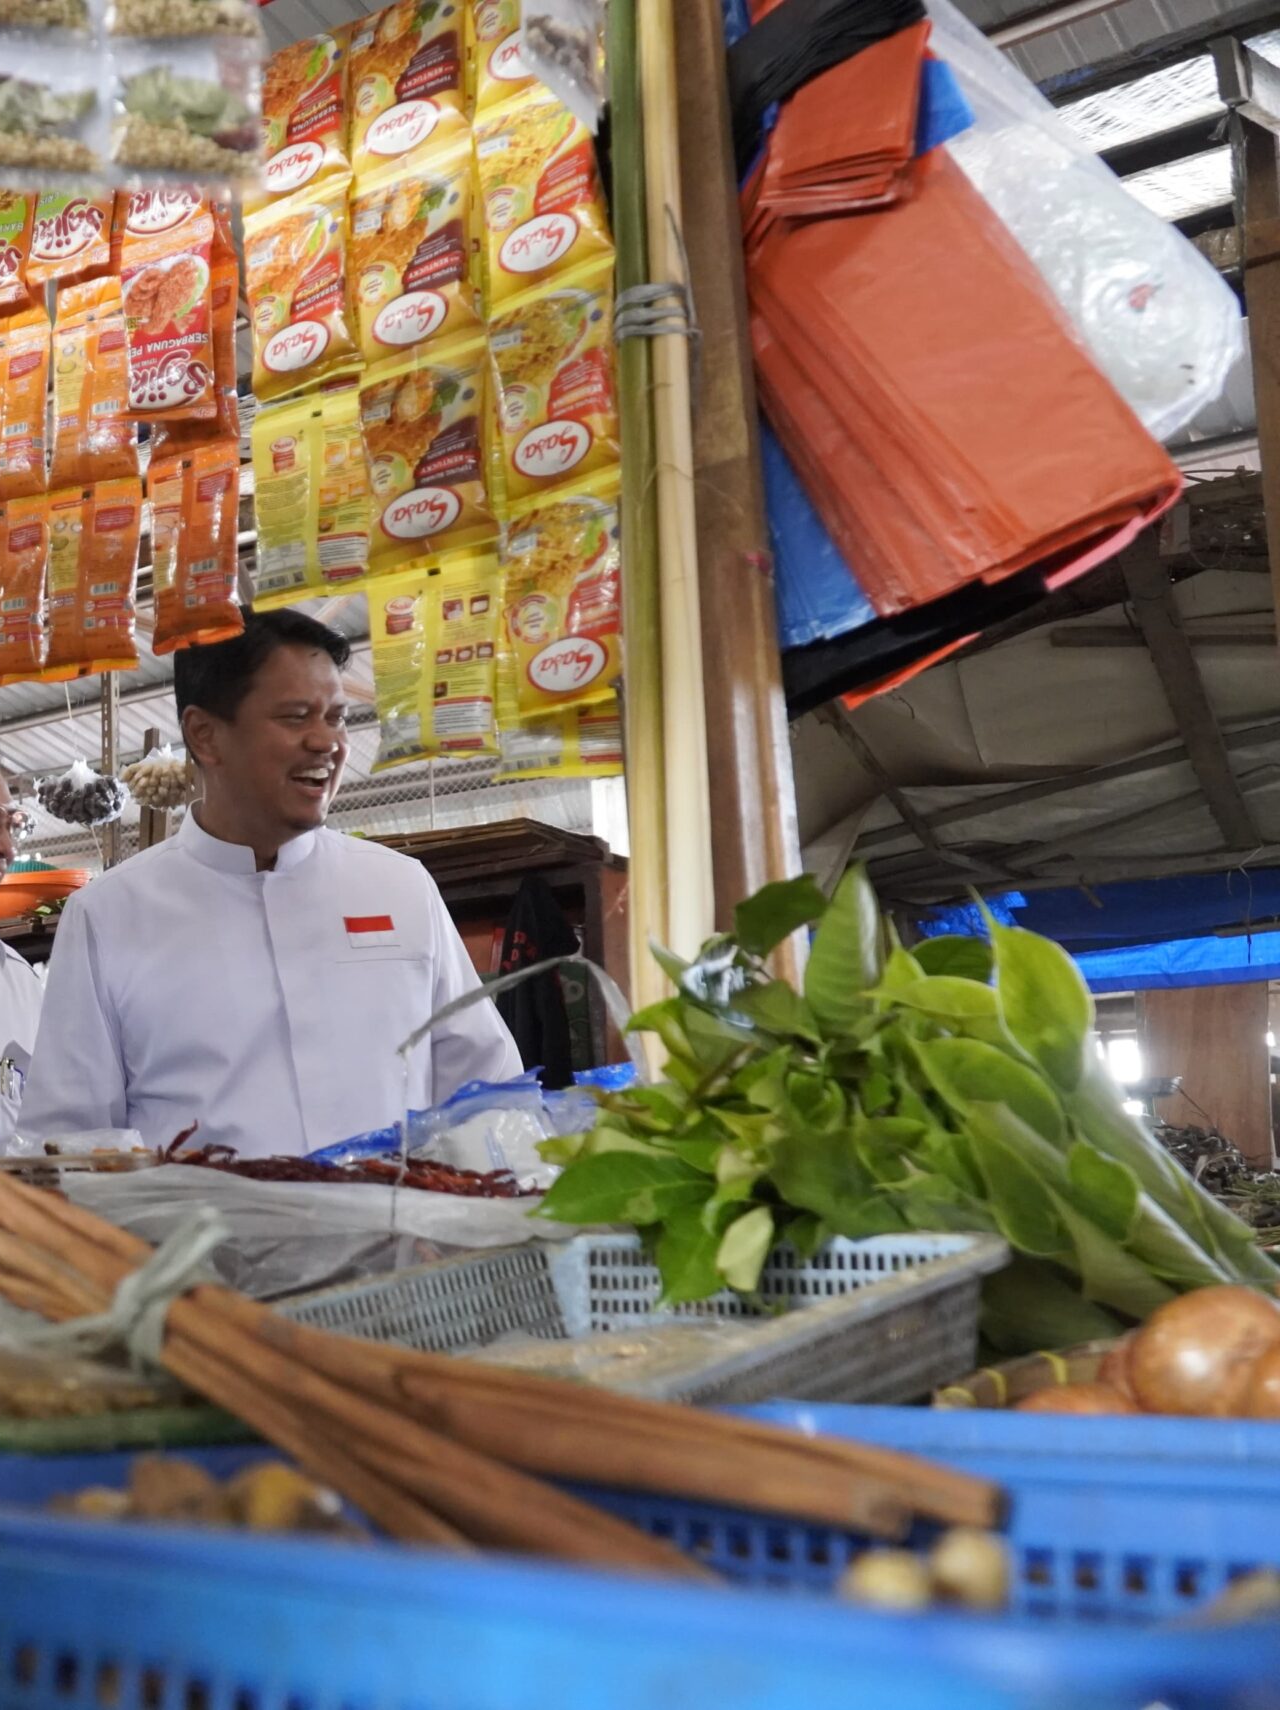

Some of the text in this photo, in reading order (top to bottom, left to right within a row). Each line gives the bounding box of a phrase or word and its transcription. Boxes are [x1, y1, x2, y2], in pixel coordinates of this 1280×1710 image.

[382, 296, 436, 334] Sasa
[146, 332, 209, 352] SERBAGUNA
[271, 326, 318, 363] Sasa
[129, 349, 209, 404] Sajik
[522, 425, 579, 465] Sasa
[391, 493, 448, 529] Sasa
[537, 643, 594, 682] Sasa
